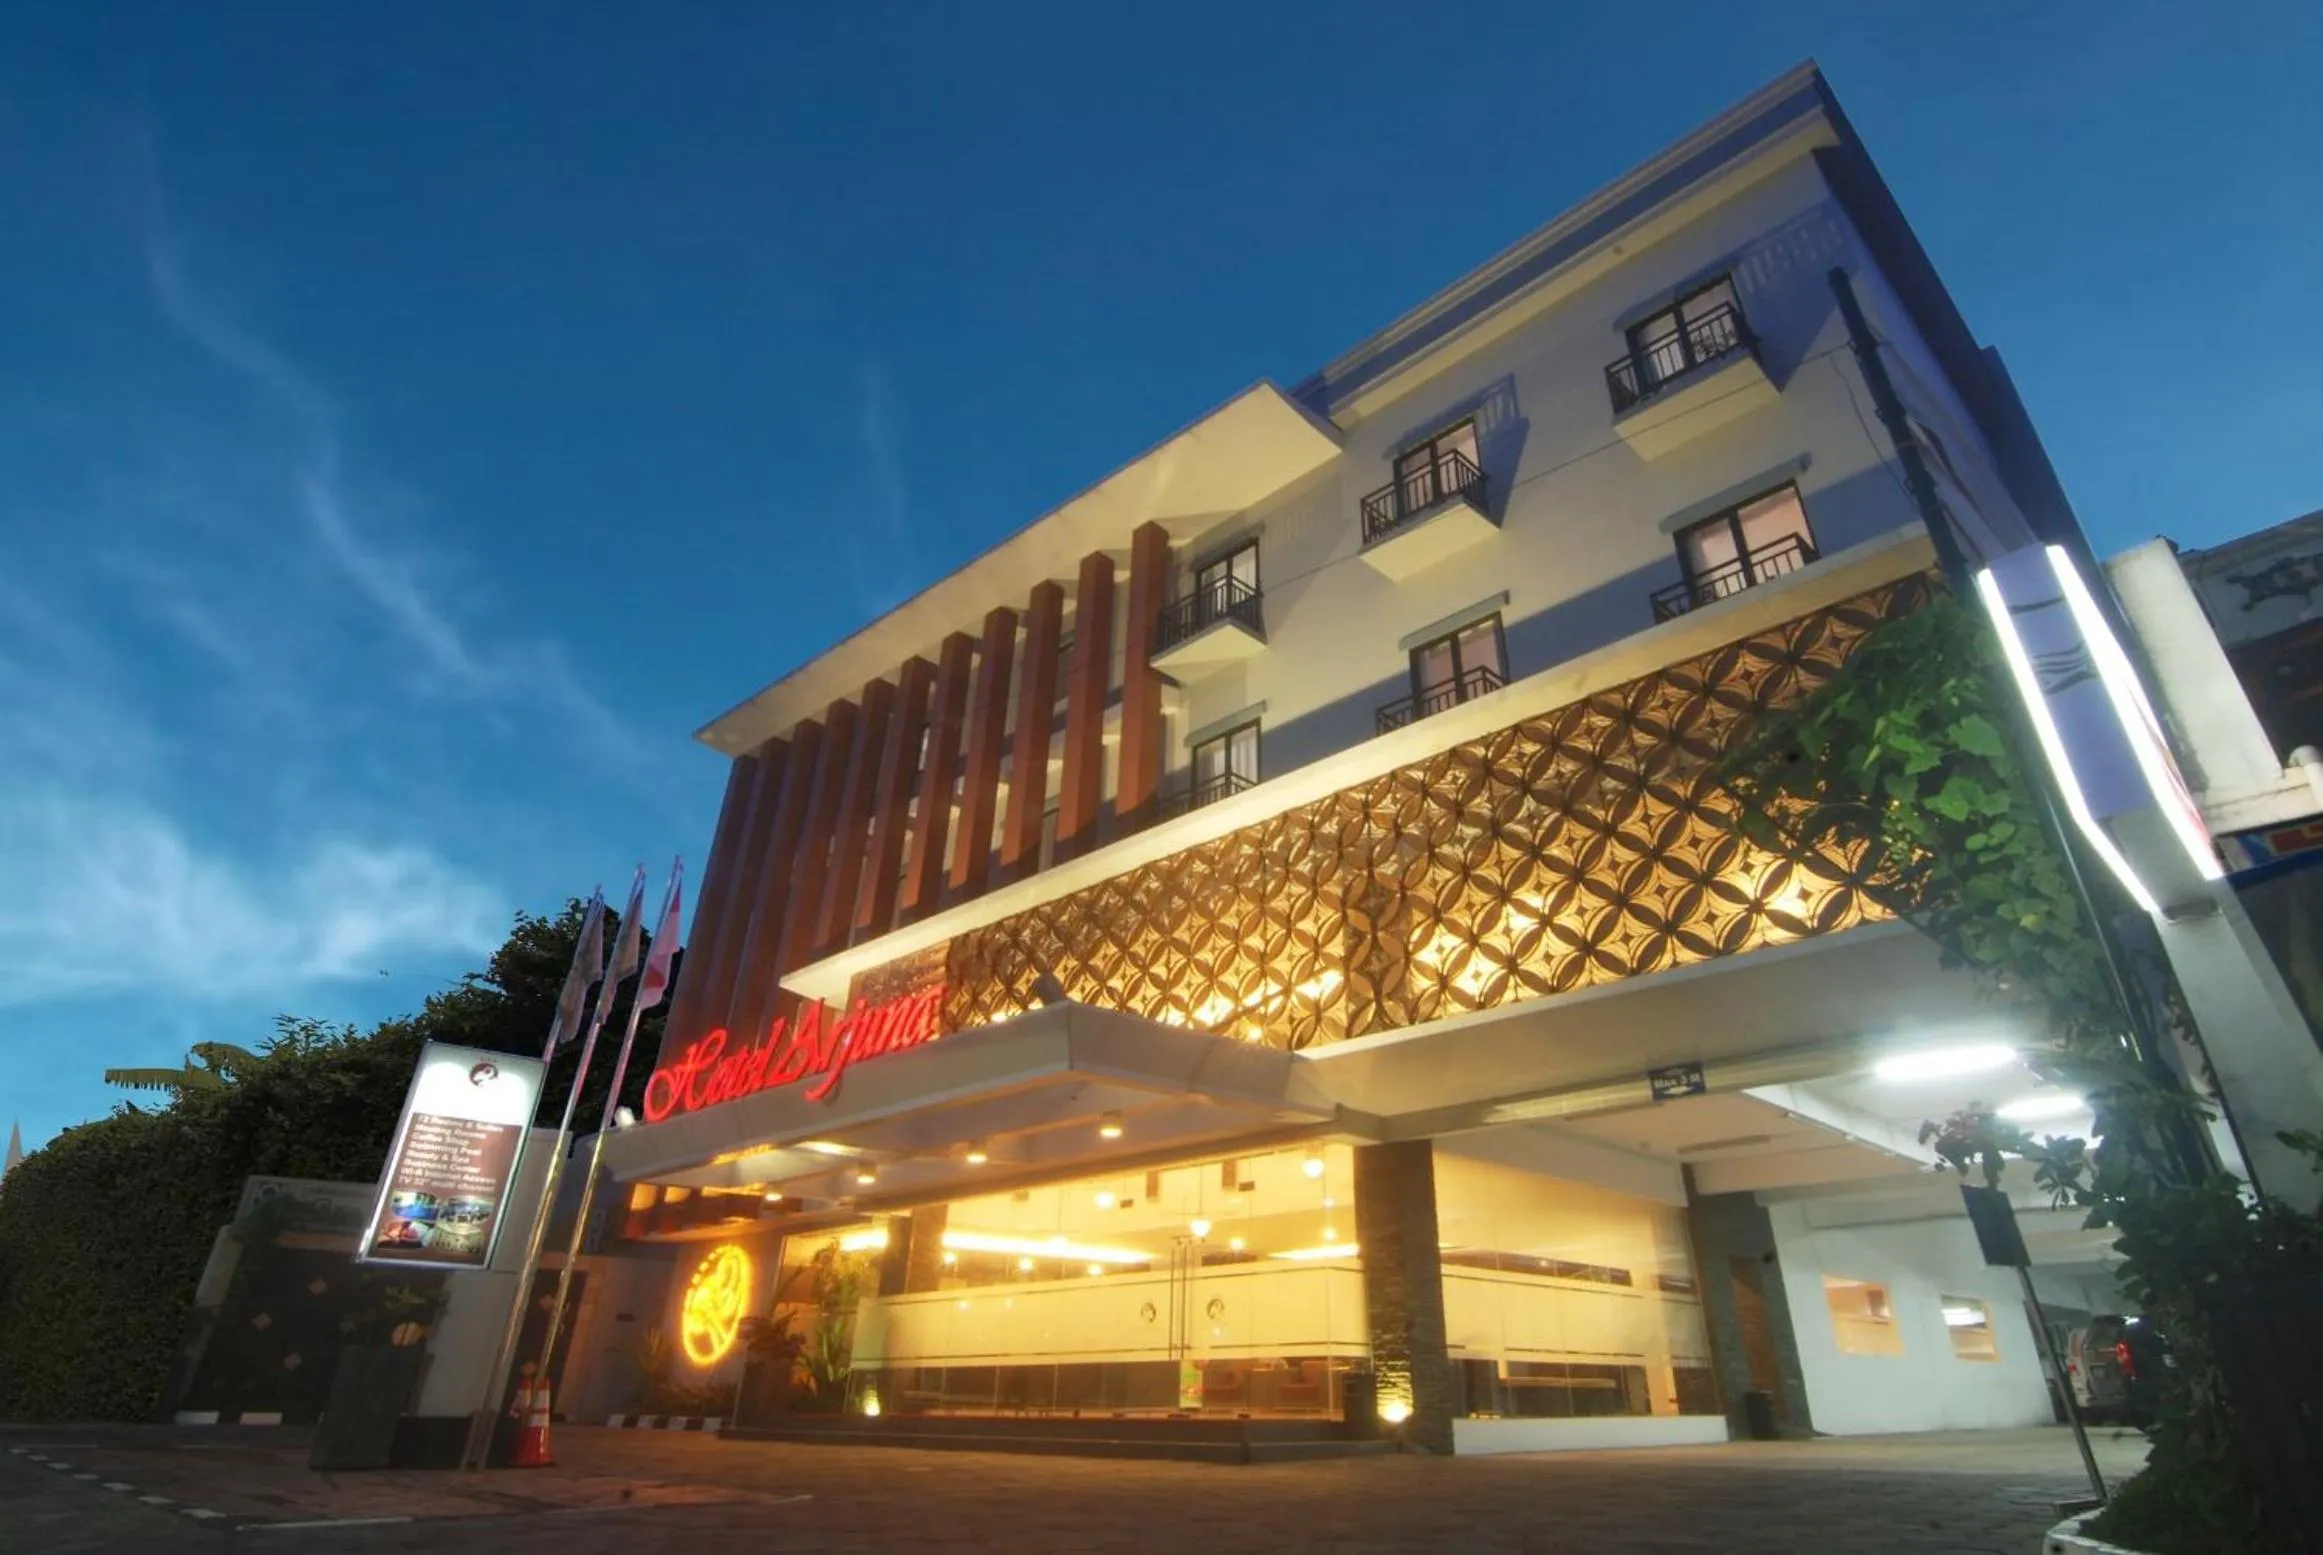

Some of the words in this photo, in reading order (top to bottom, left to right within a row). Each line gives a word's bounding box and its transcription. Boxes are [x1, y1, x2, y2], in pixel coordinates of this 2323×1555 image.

[644, 1015, 787, 1124] Hotel
[767, 980, 949, 1103] Arjuna
[414, 1124, 452, 1136] Meeting
[411, 1132, 443, 1143] Coffee
[403, 1158, 448, 1170] Business
[398, 1174, 413, 1184] TV
[424, 1169, 461, 1181] Internet
[462, 1174, 496, 1185] Access
